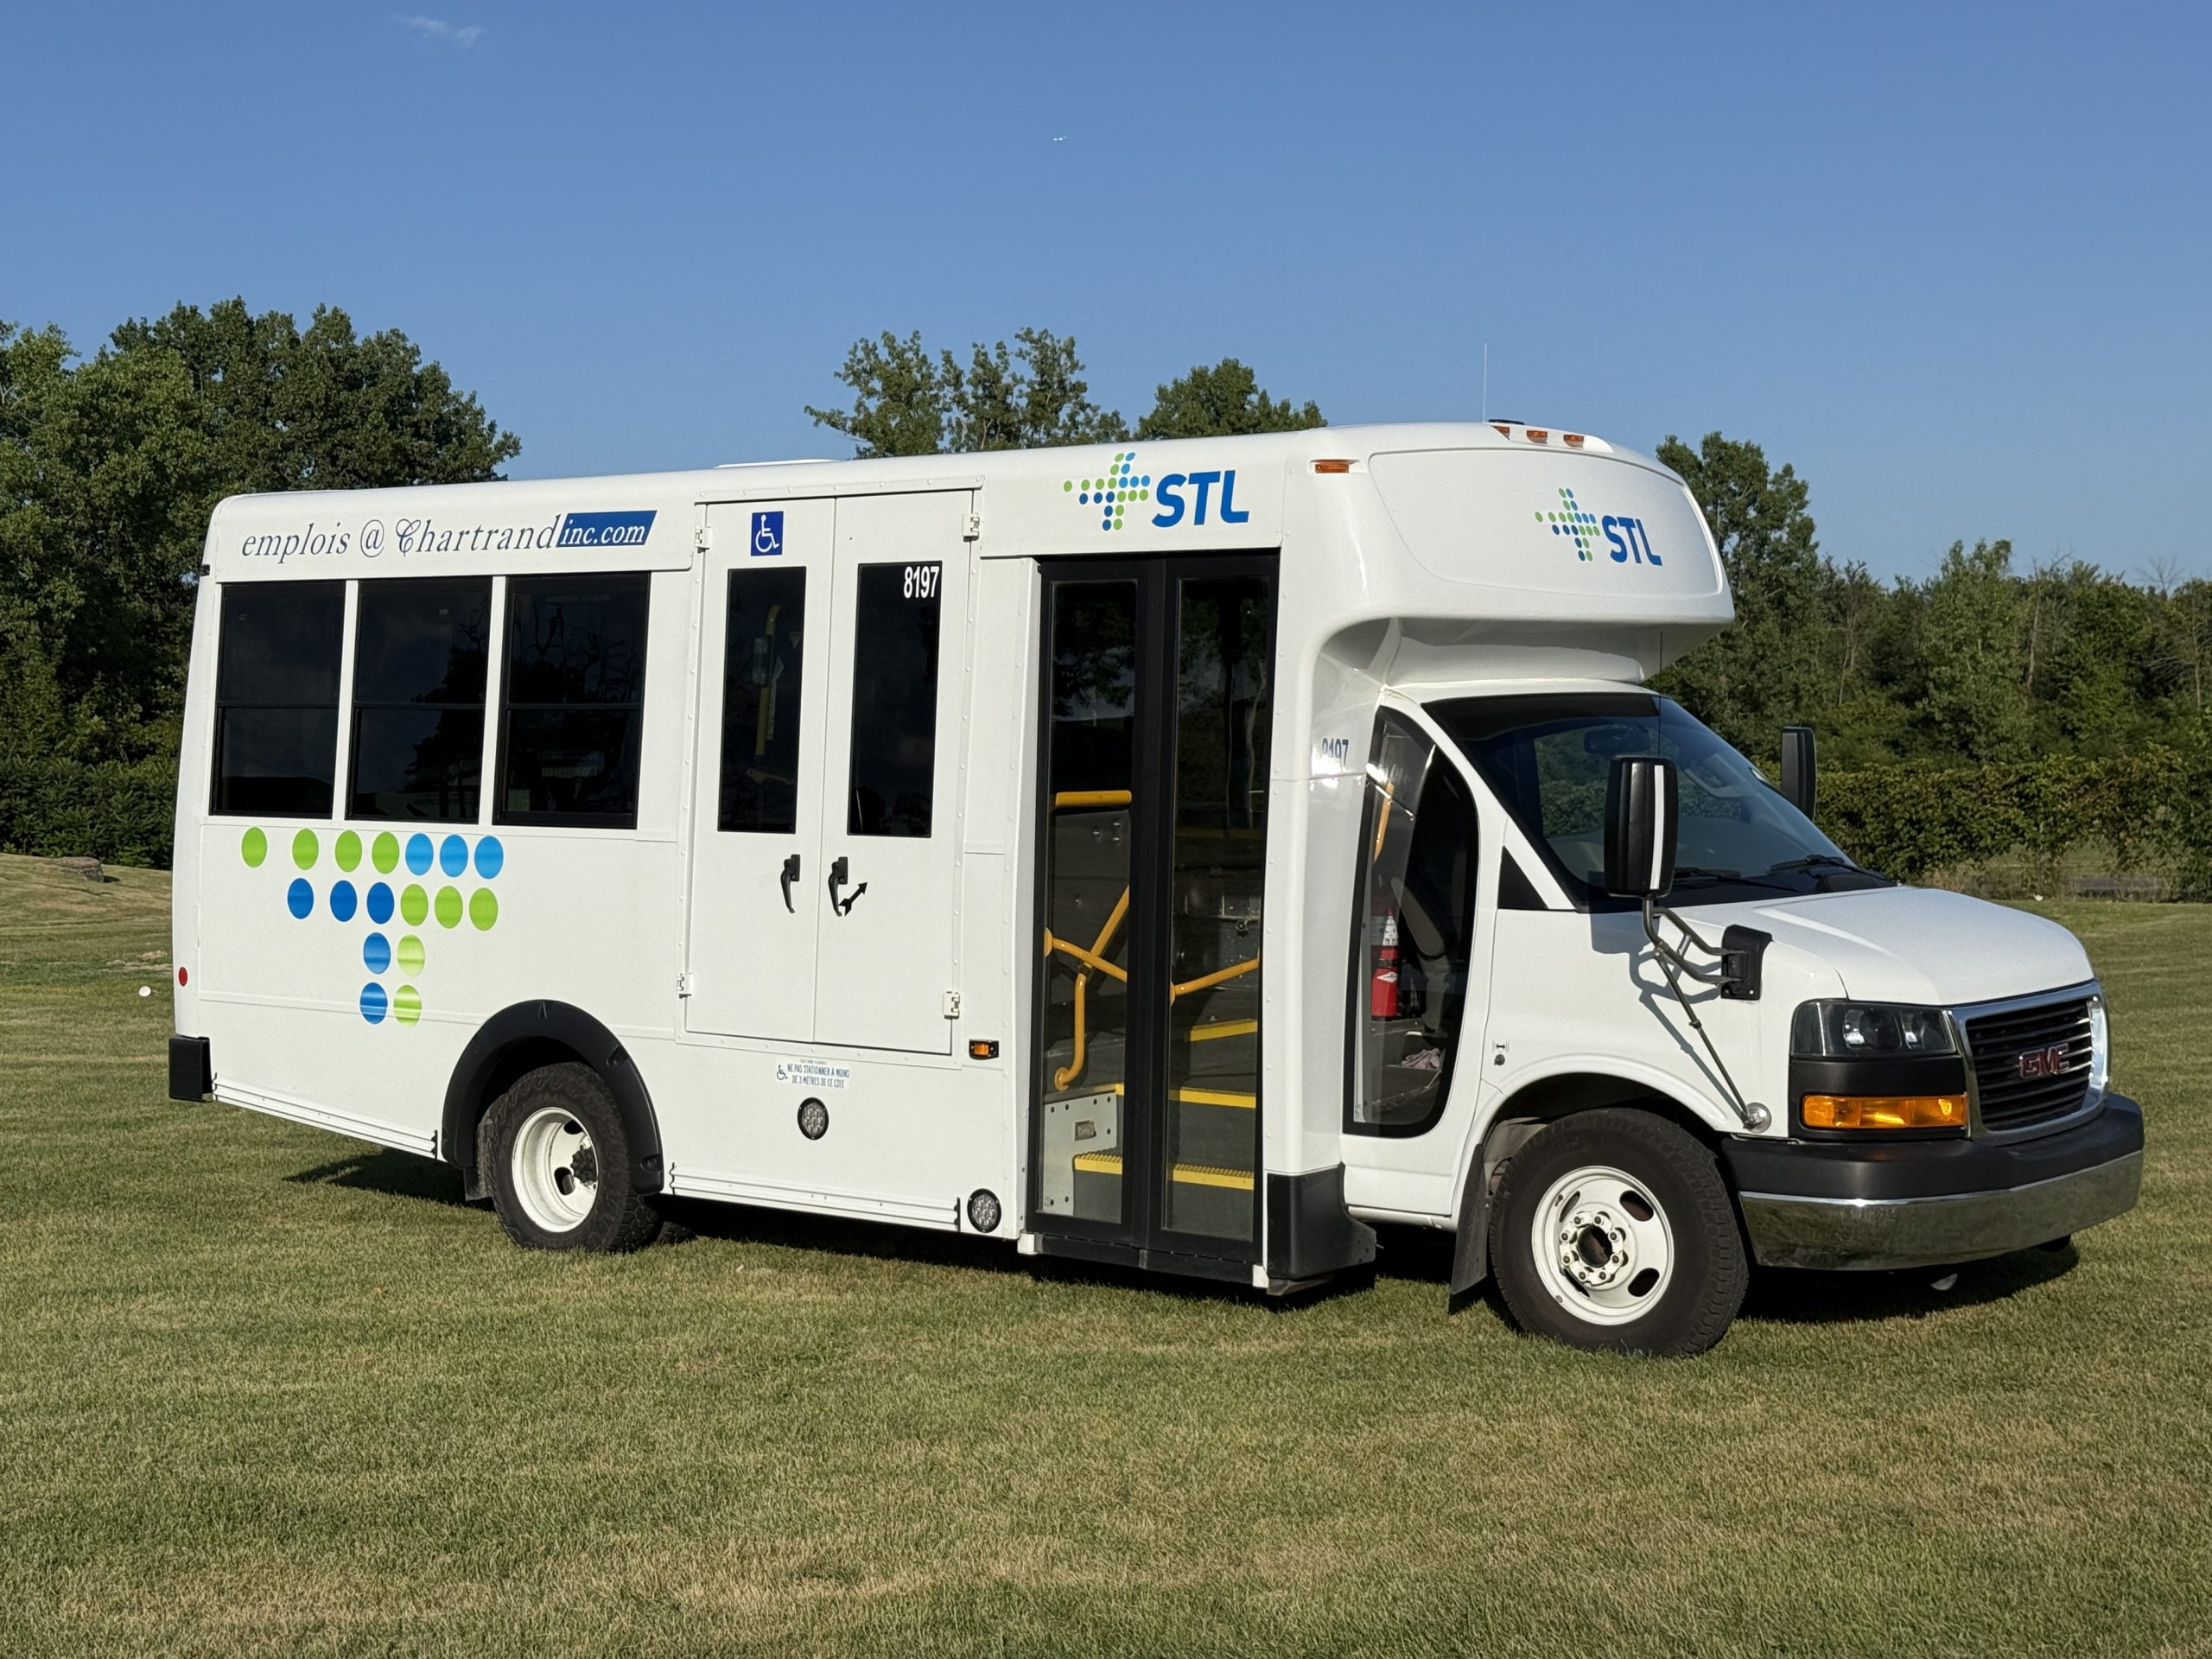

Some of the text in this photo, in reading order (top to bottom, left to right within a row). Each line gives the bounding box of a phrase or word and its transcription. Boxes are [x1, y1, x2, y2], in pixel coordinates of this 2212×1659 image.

[1152, 470, 1249, 528] STL
[242, 522, 350, 563] emplois
[360, 519, 385, 557] @
[1602, 515, 1663, 567] STL
[904, 566, 940, 598] 8197
[794, 1064, 803, 1073] PAS
[804, 1065, 830, 1076] STATIONNER
[2018, 1042, 2070, 1079] GMC
